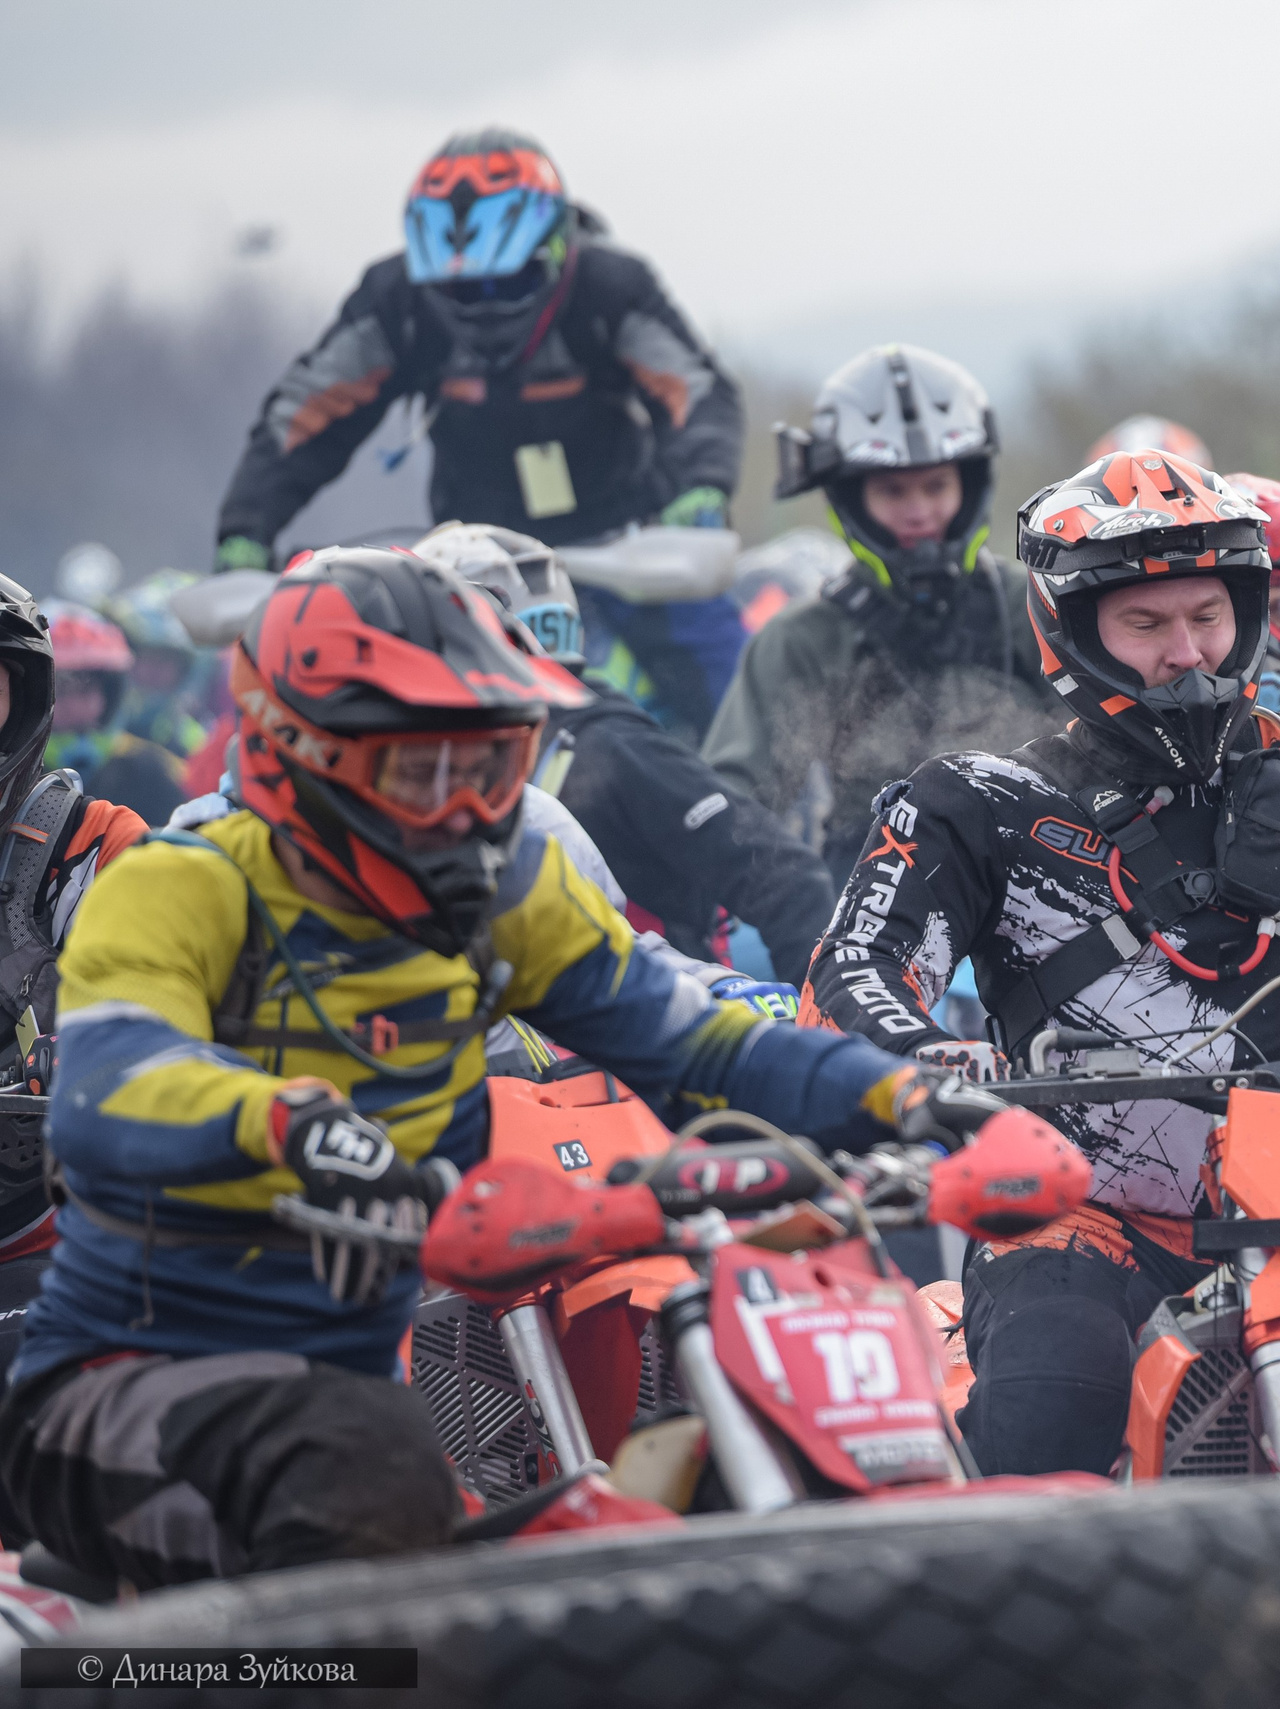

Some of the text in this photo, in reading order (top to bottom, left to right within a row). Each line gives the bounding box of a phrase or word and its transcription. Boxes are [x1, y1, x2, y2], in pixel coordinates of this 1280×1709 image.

[1096, 512, 1162, 534] Airoh
[1154, 726, 1187, 769] AIROH
[560, 1142, 590, 1168] 43
